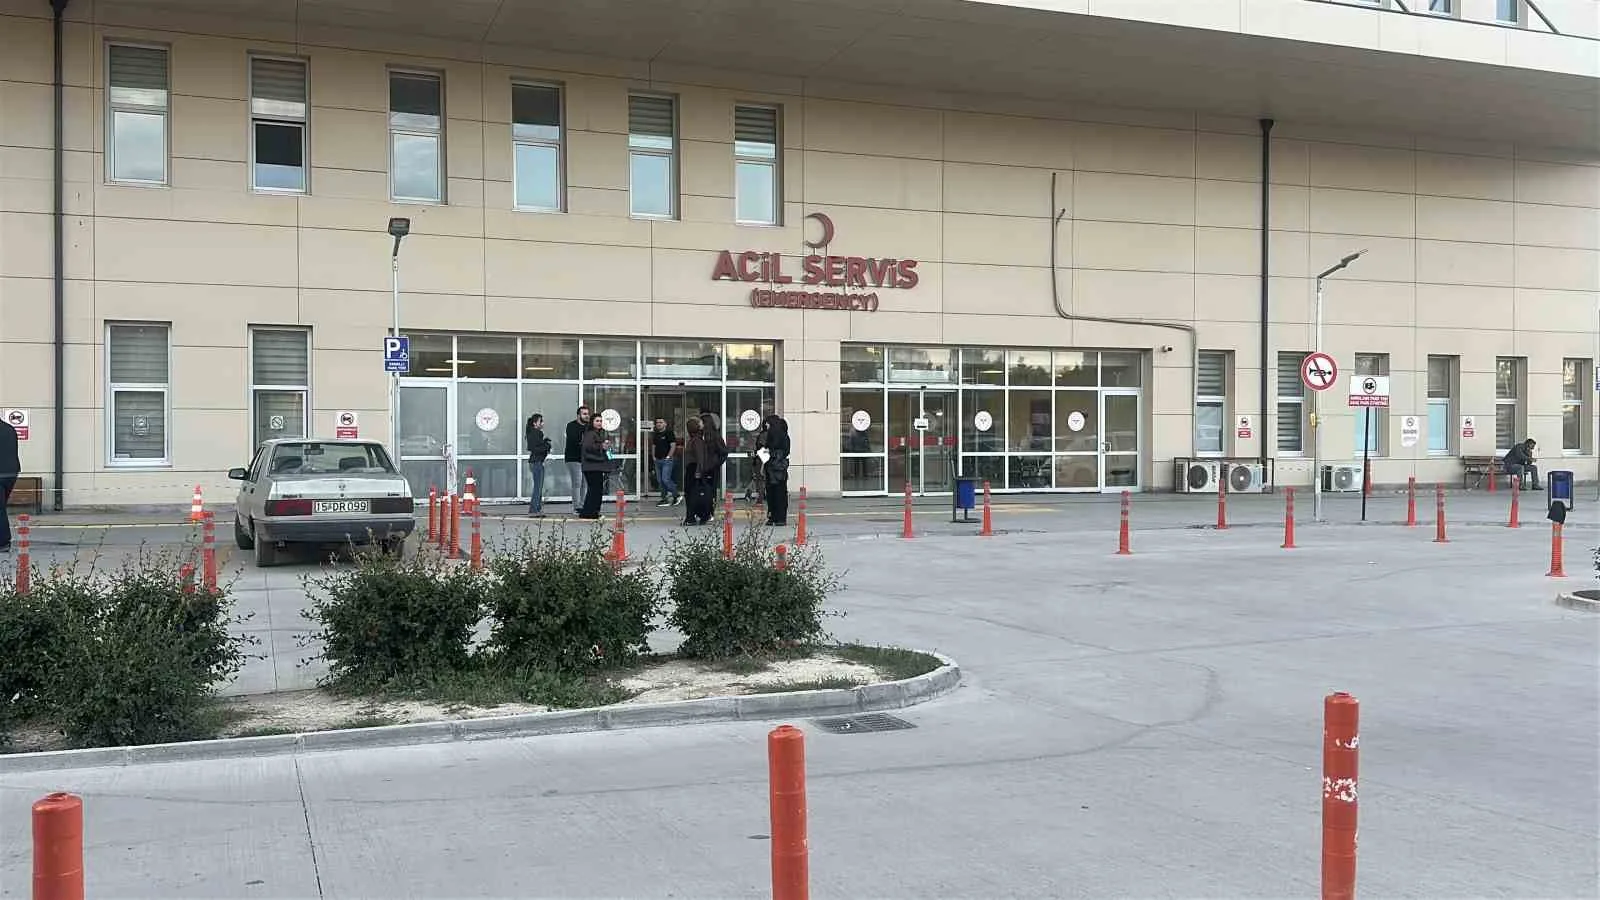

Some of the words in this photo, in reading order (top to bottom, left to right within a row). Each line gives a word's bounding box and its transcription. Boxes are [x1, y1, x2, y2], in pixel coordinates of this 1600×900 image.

[386, 338, 401, 359] P
[316, 502, 328, 511] 15
[332, 502, 346, 511] DR
